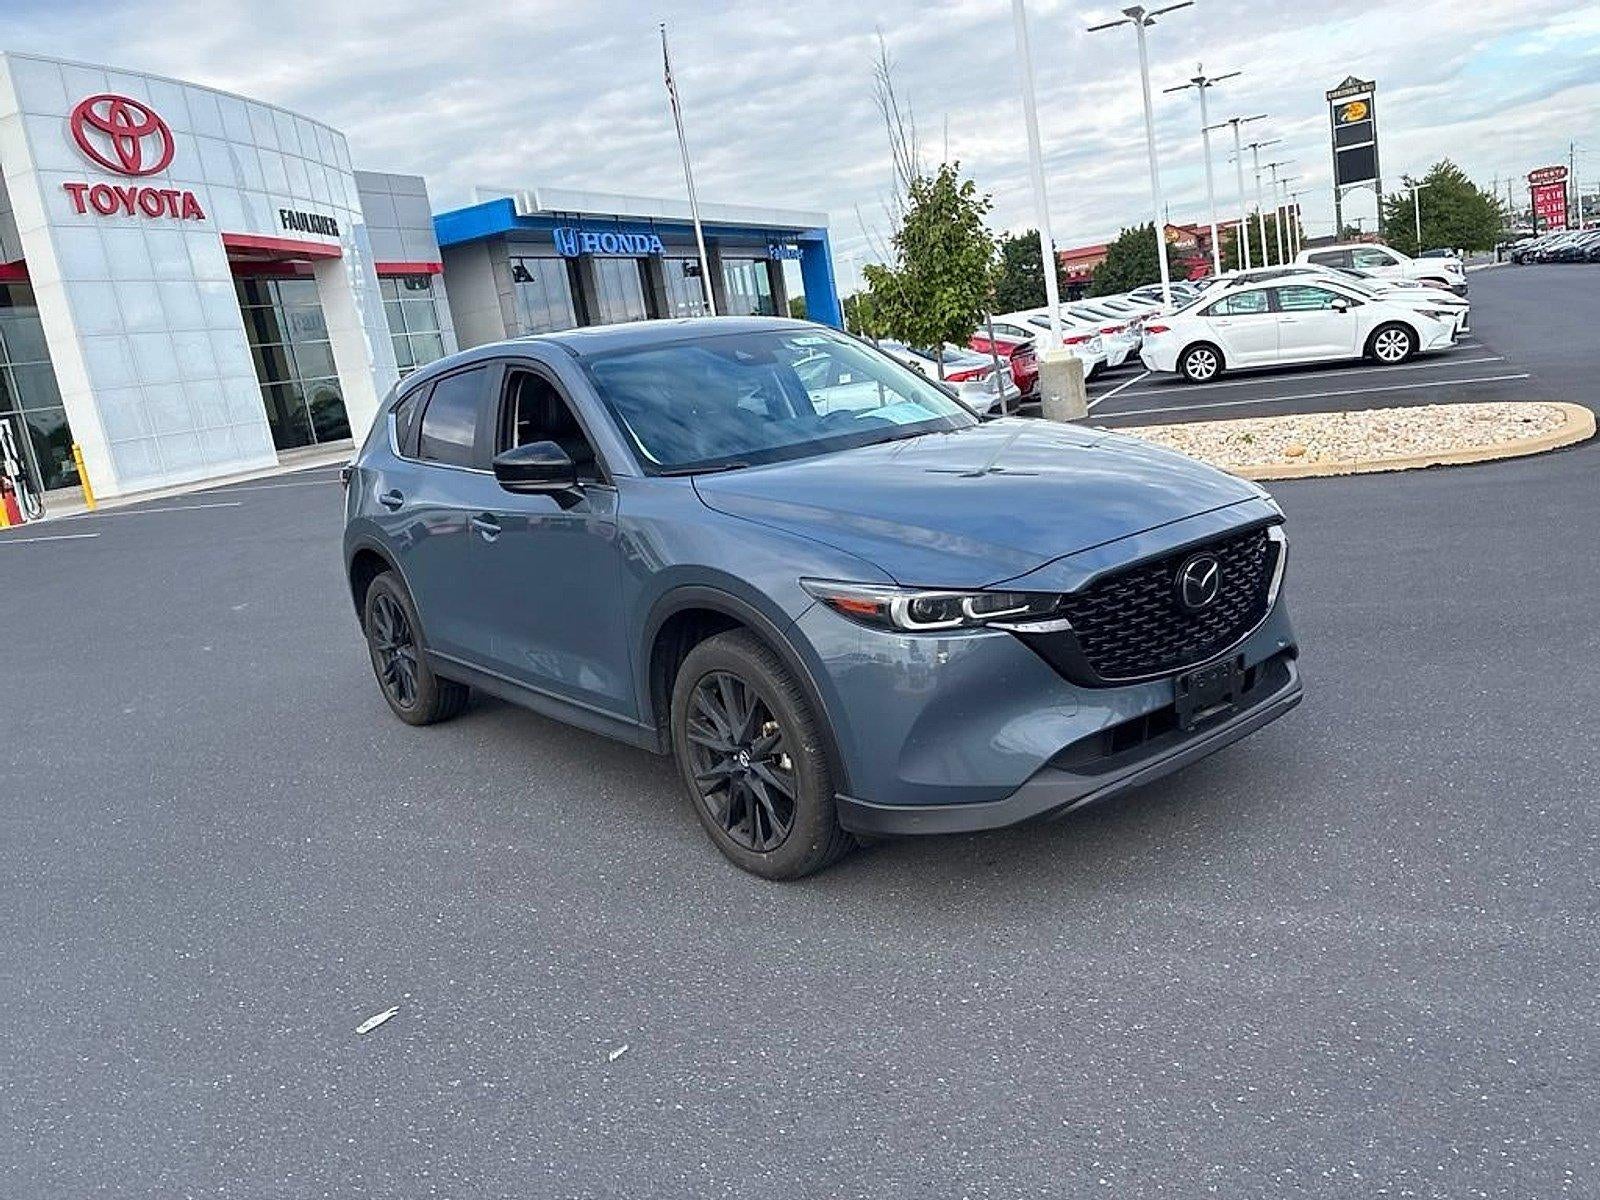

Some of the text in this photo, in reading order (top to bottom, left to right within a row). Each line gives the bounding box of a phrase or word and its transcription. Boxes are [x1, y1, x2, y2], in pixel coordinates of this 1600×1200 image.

[63, 183, 206, 220] TOYOTA
[279, 208, 341, 238] FAULKNER
[578, 232, 667, 255] HONDA
